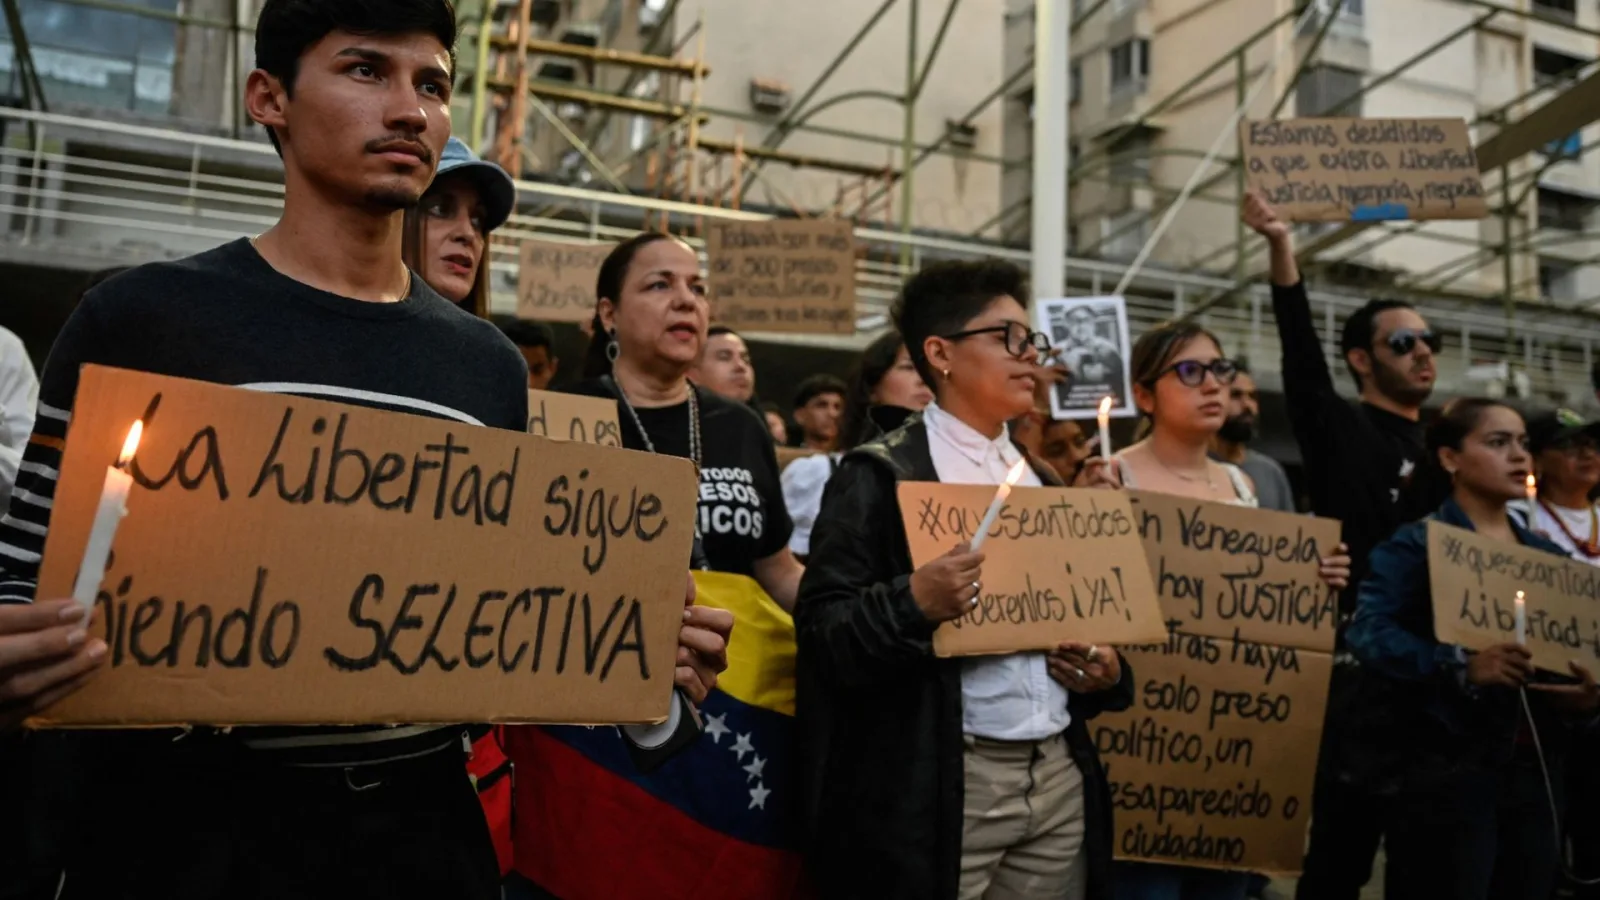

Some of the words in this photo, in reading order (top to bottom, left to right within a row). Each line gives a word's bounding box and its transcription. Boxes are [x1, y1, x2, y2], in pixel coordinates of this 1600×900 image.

[1346, 120, 1446, 144] decididos
[1250, 154, 1267, 173] a
[1270, 152, 1309, 180] que
[1262, 180, 1342, 210] usticia,
[115, 391, 230, 500] La
[544, 469, 669, 575] sigue
[701, 467, 753, 484] TODOS
[1131, 497, 1162, 543] n
[1177, 505, 1321, 577] Venezuela
[1158, 556, 1204, 620] hay
[1441, 535, 1600, 601] #queseantod
[325, 573, 651, 682] SELECTIVA
[1232, 627, 1301, 685] haya
[1143, 675, 1199, 714] solo
[1210, 688, 1290, 731] preso
[1104, 762, 1271, 825] esaparecido
[1283, 795, 1299, 820] o
[1121, 823, 1246, 863] ciudadano
